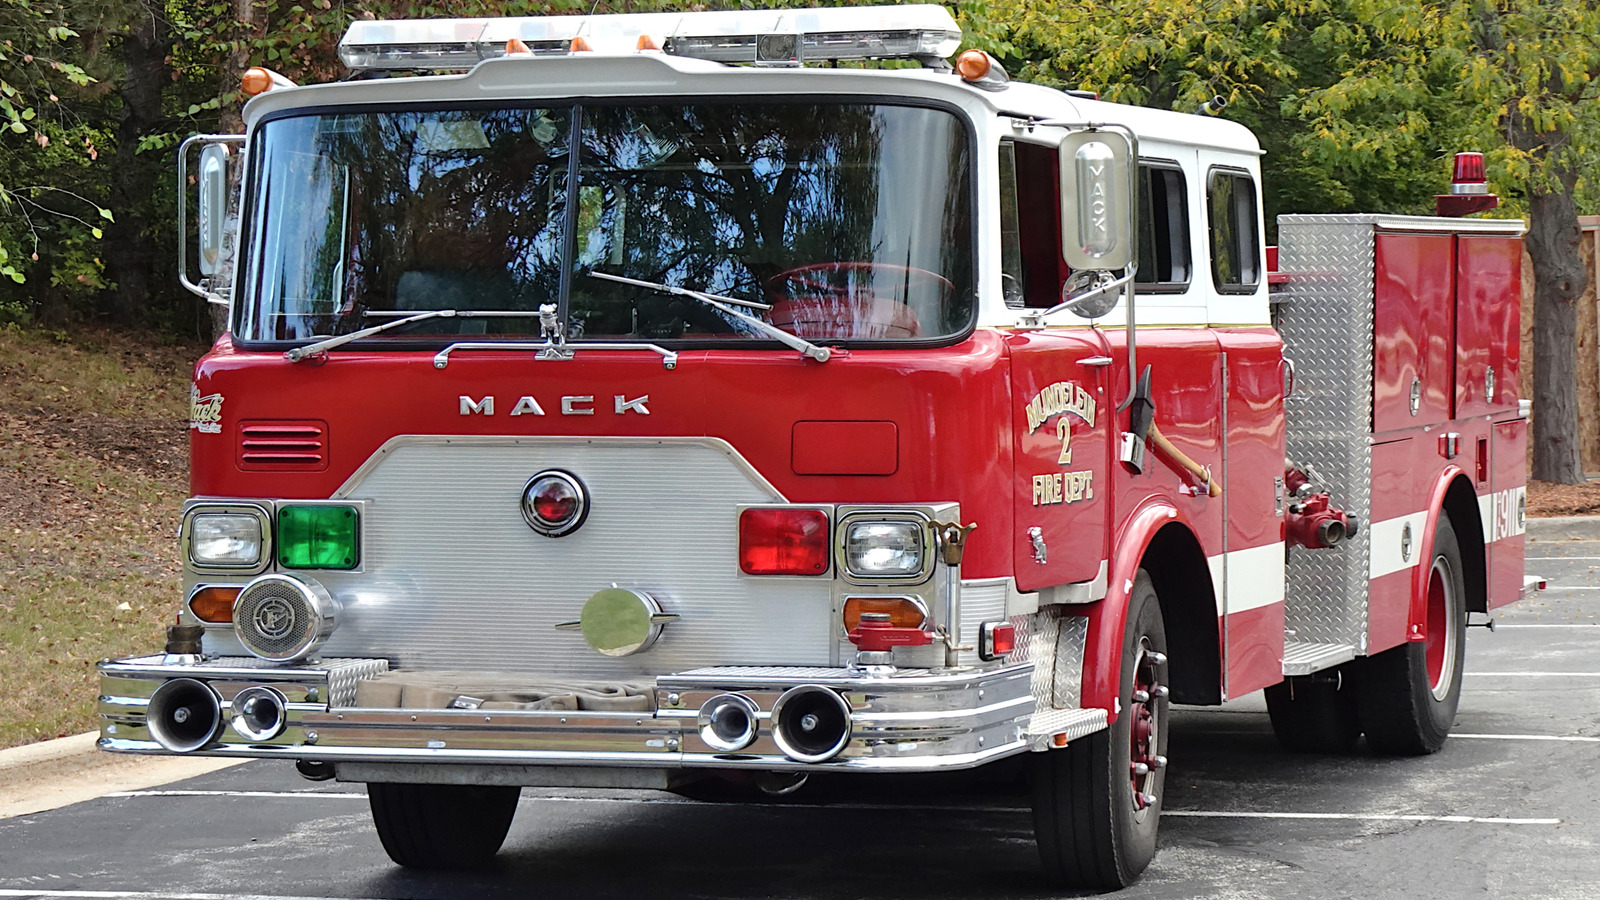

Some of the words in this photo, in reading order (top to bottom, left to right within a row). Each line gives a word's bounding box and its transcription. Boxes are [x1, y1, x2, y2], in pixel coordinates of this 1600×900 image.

[191, 394, 225, 422] ack
[459, 395, 650, 416] MACK
[1025, 381, 1097, 436] MUNDELEIN
[1056, 416, 1072, 465] 2
[1032, 473, 1063, 506] FIRE
[1064, 470, 1093, 504] DEPT.
